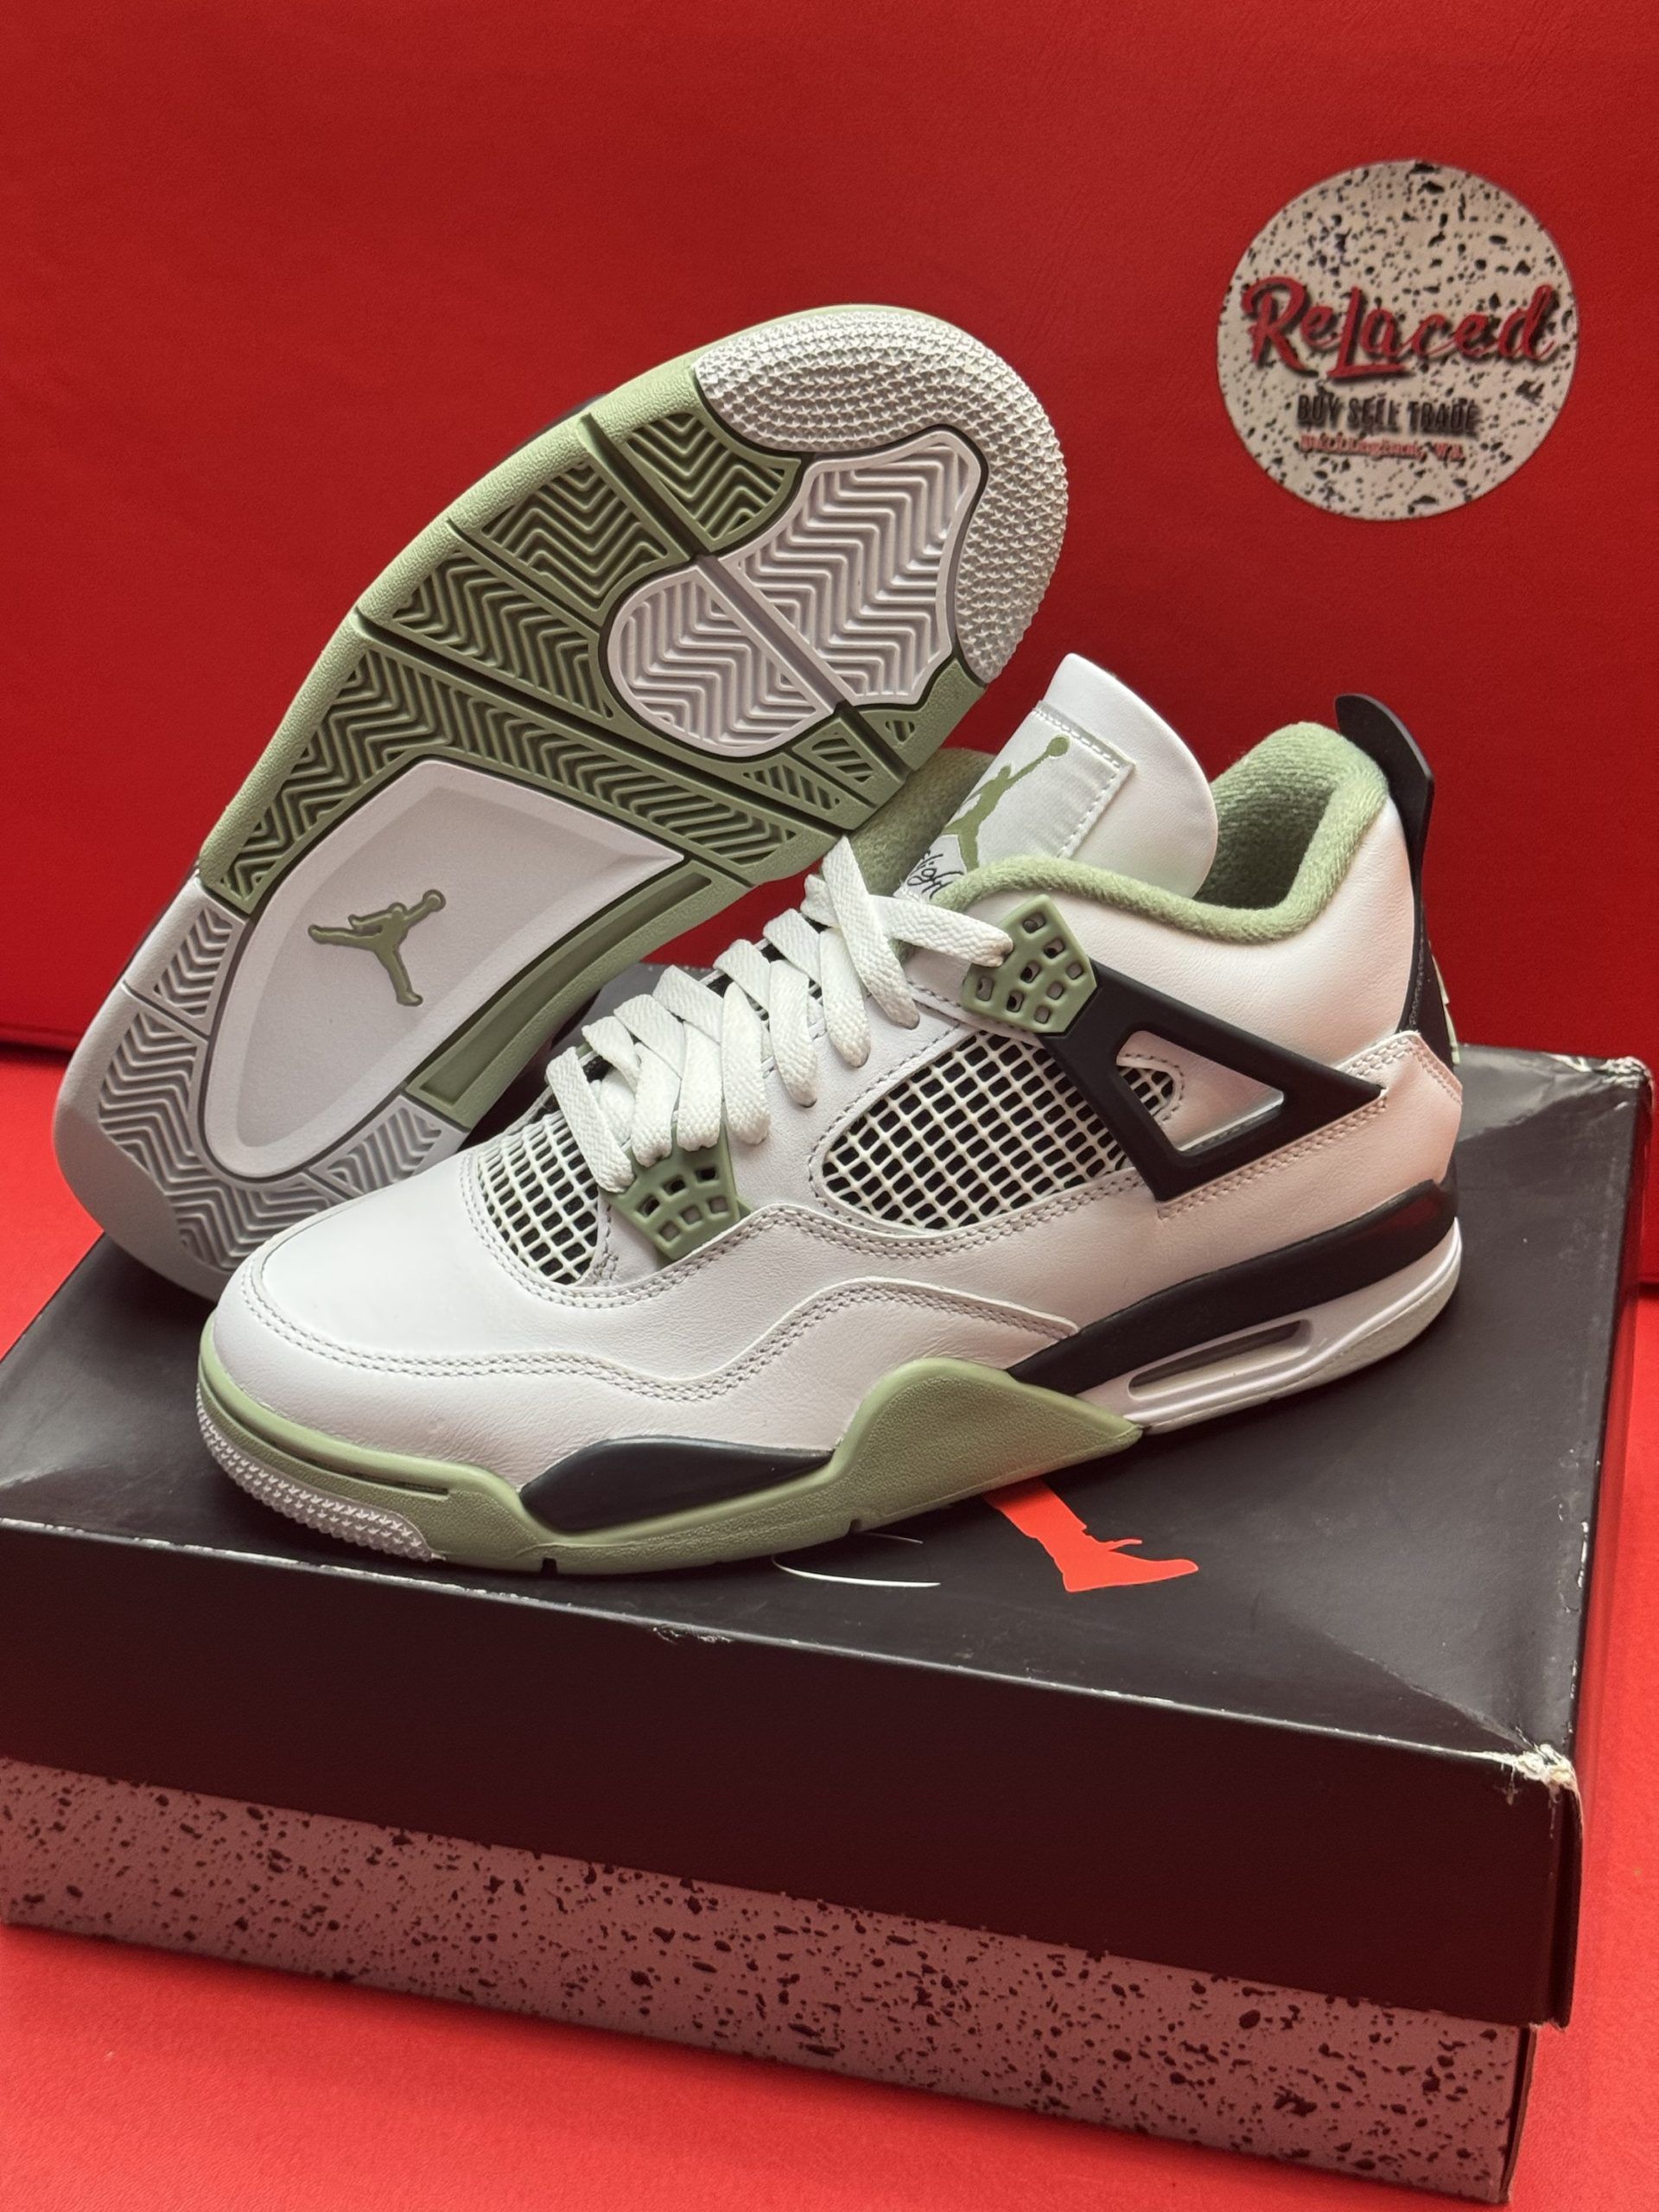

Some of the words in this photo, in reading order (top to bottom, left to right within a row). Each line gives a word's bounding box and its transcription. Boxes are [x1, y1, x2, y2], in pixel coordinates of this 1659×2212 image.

[1242, 276, 1559, 379] ReLaced
[1297, 394, 1340, 427] BUY
[1347, 396, 1400, 430] SELL
[1408, 398, 1480, 435] TRADE
